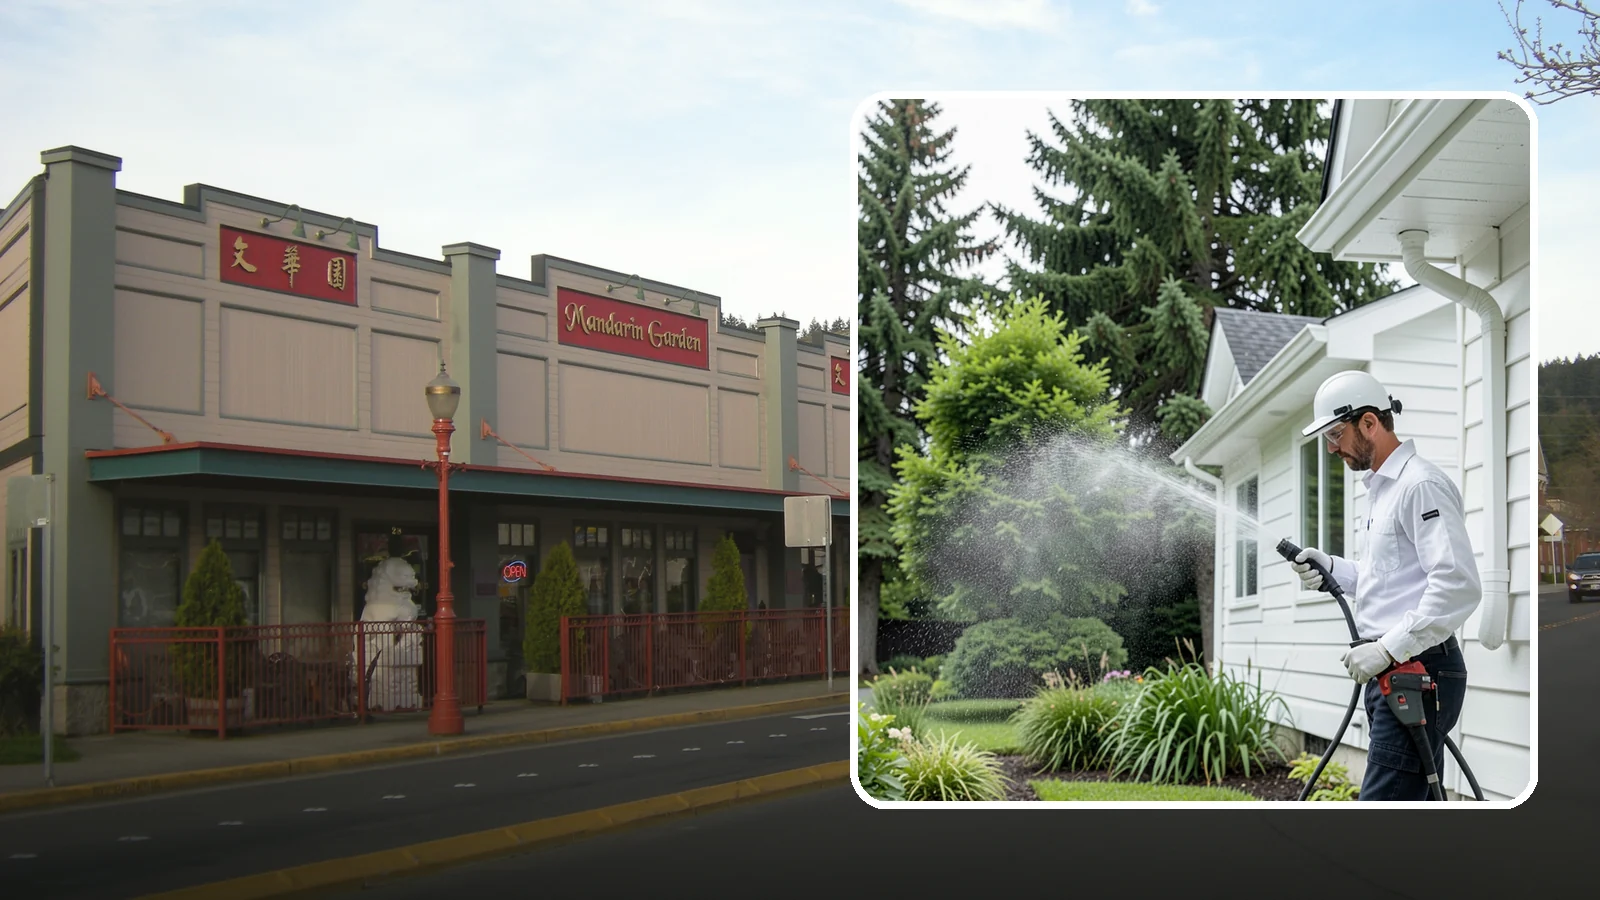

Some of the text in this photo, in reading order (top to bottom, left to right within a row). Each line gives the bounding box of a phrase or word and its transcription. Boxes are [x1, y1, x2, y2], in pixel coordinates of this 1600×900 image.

[230, 235, 346, 291] 文華園
[564, 302, 701, 352] Mandarin Garden
[503, 565, 527, 578] OPEN
